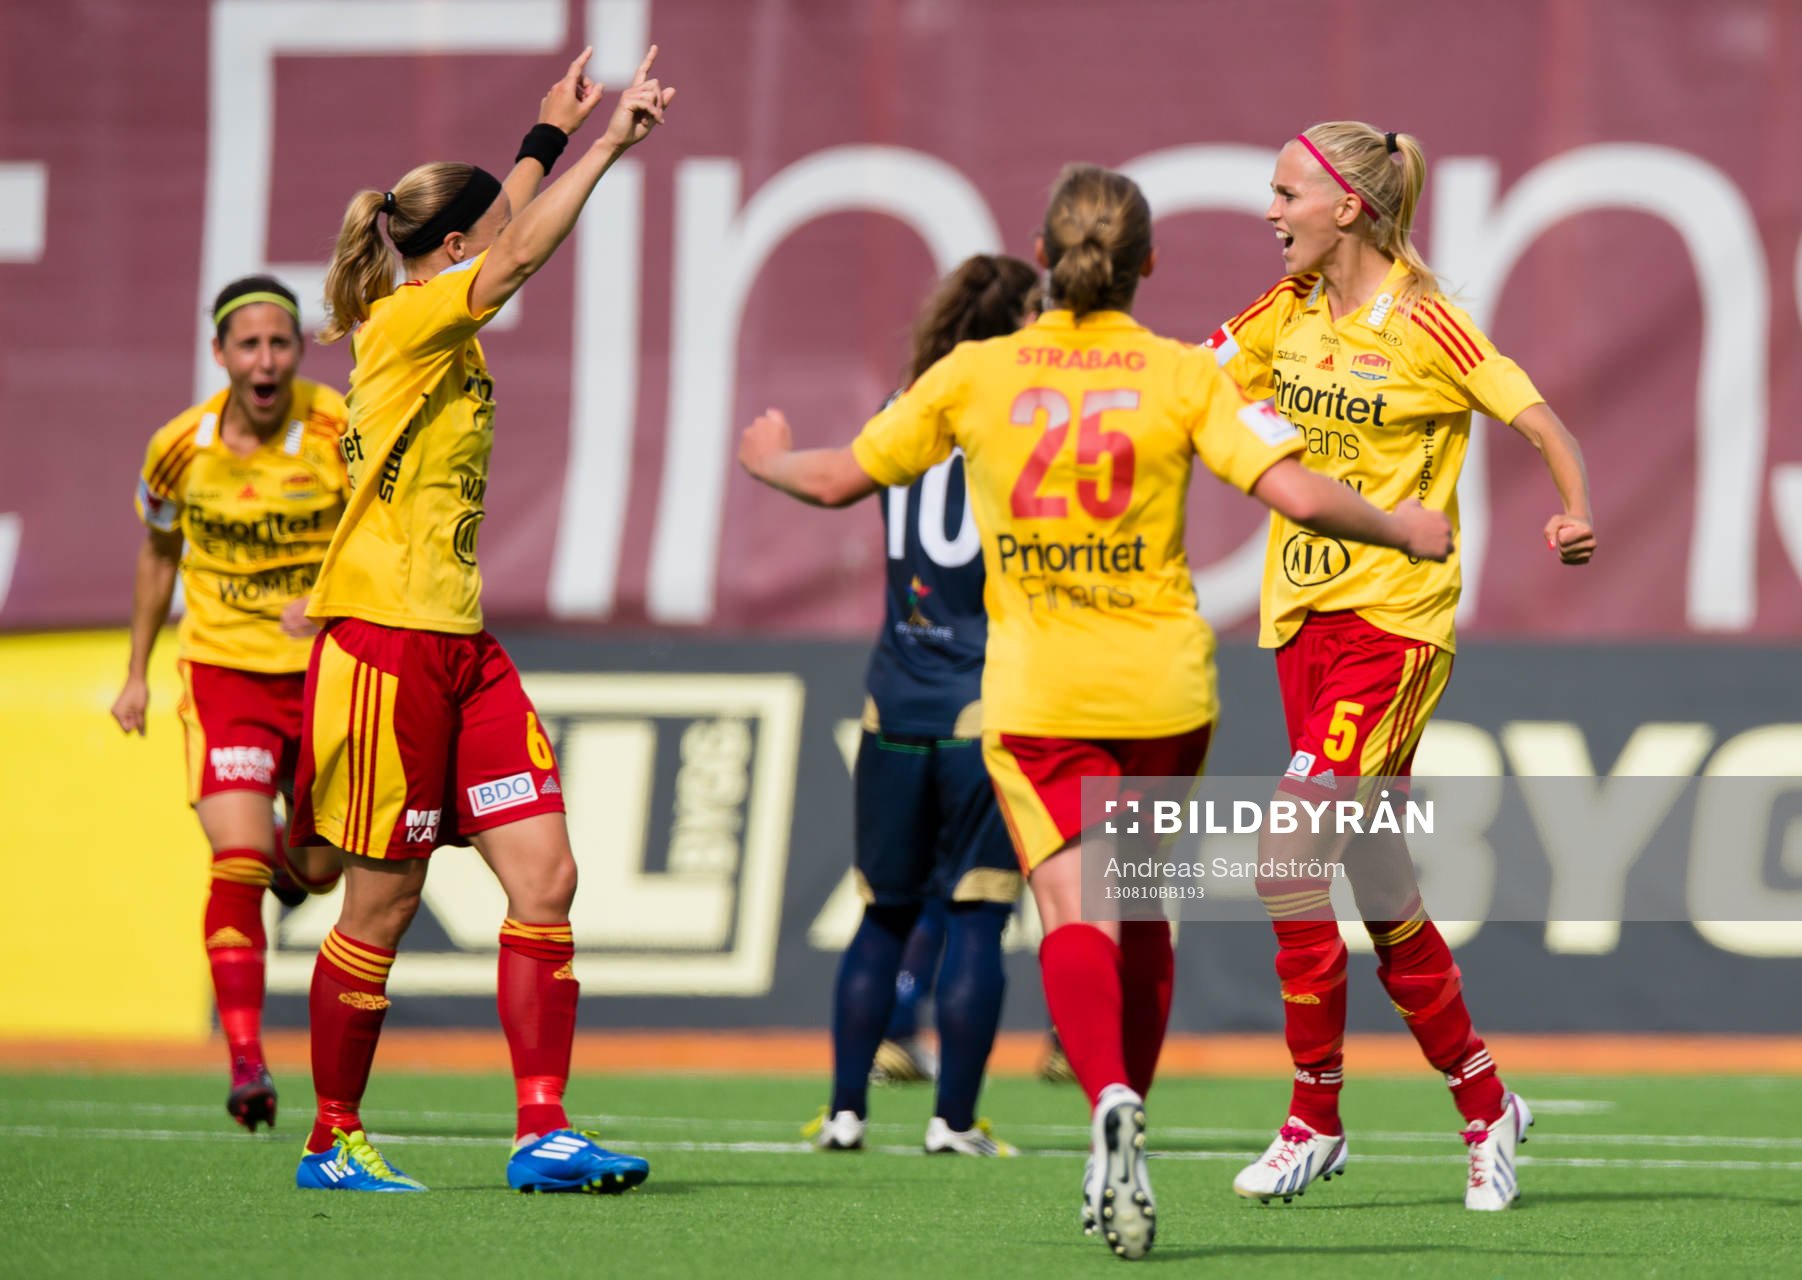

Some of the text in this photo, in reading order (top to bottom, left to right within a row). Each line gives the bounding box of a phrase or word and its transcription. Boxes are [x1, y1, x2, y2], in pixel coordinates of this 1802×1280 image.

[1016, 347, 1147, 372] STRABAG
[1273, 369, 1387, 427] Prioritet
[1009, 386, 1142, 520] 25
[1418, 419, 1437, 501] roperties
[888, 445, 982, 568] 10
[997, 532, 1147, 574] Prioritet
[1020, 575, 1135, 613] Finans
[526, 711, 554, 770] 6
[1323, 700, 1365, 763] 5
[479, 777, 531, 806] BDO
